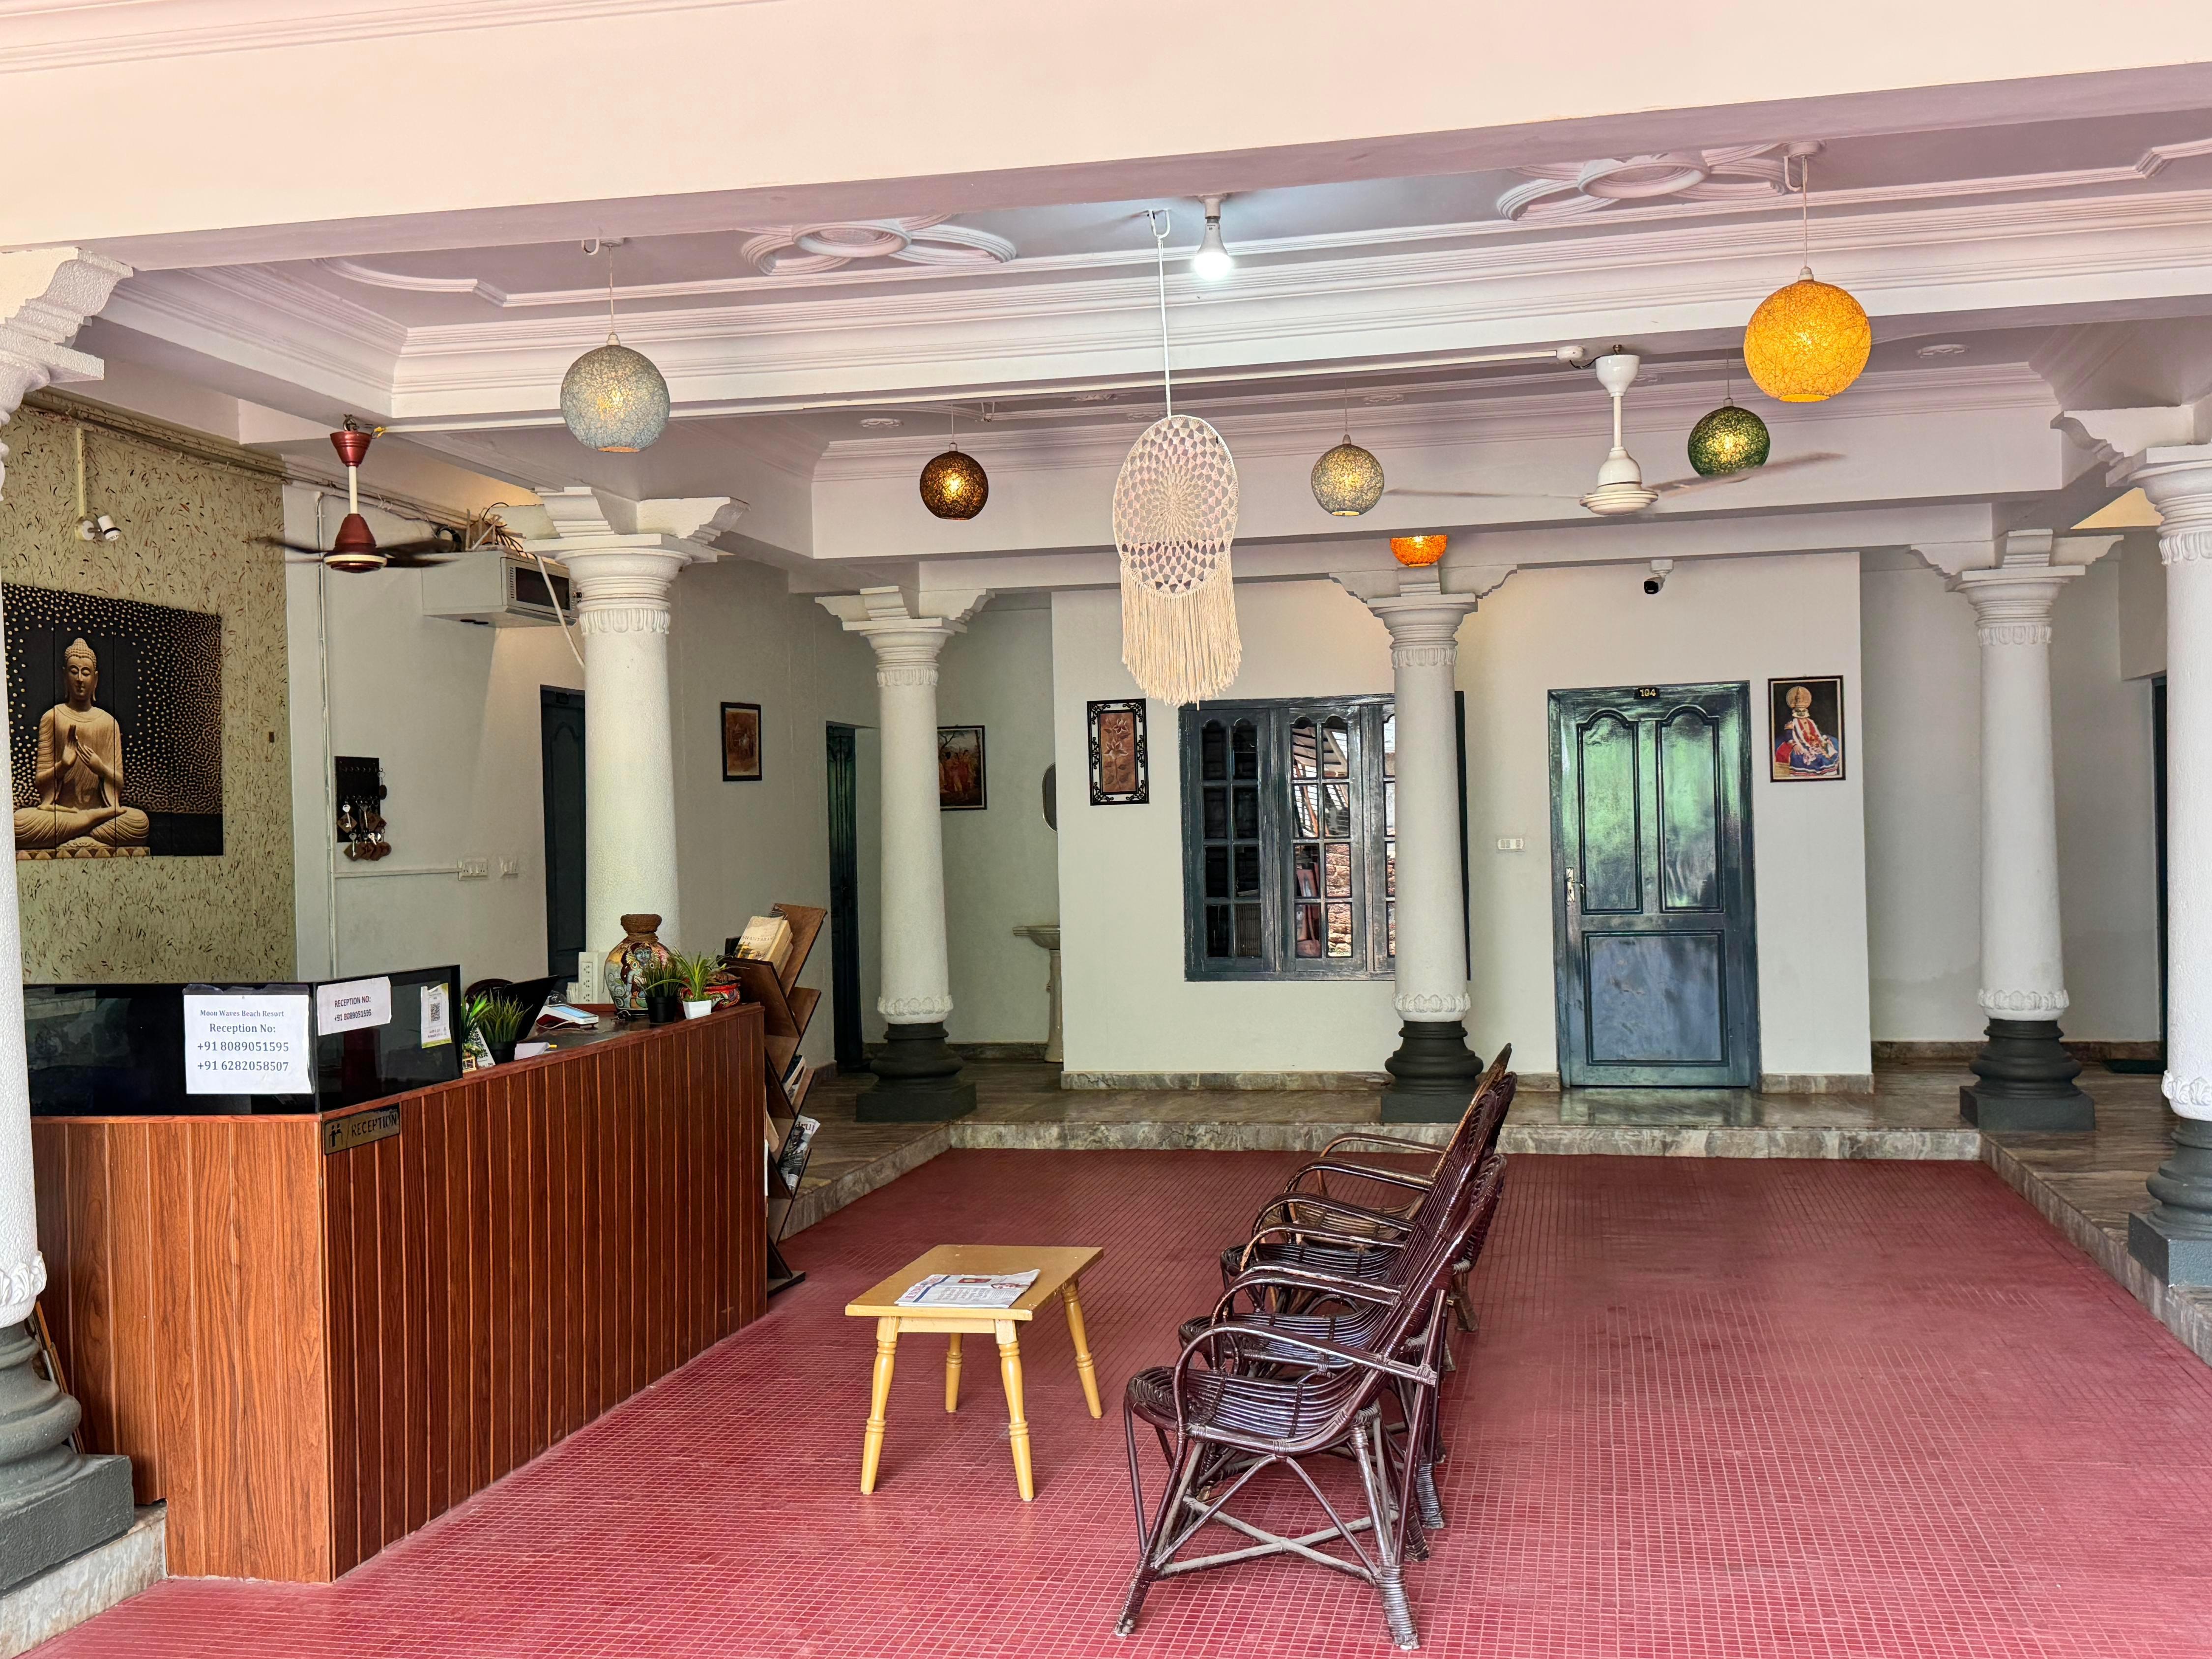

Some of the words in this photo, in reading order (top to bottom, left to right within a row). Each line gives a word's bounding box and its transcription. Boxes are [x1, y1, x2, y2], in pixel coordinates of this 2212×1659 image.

[334, 996, 361, 1008] RECEPTION
[209, 1023, 258, 1034] Reception
[260, 1024, 276, 1033] No:
[197, 1041, 218, 1051] +91
[220, 1042, 289, 1051] 8089051595
[197, 1061, 218, 1070] +91
[221, 1061, 289, 1071] 6282058507
[351, 1112, 397, 1137] RECEPTION
